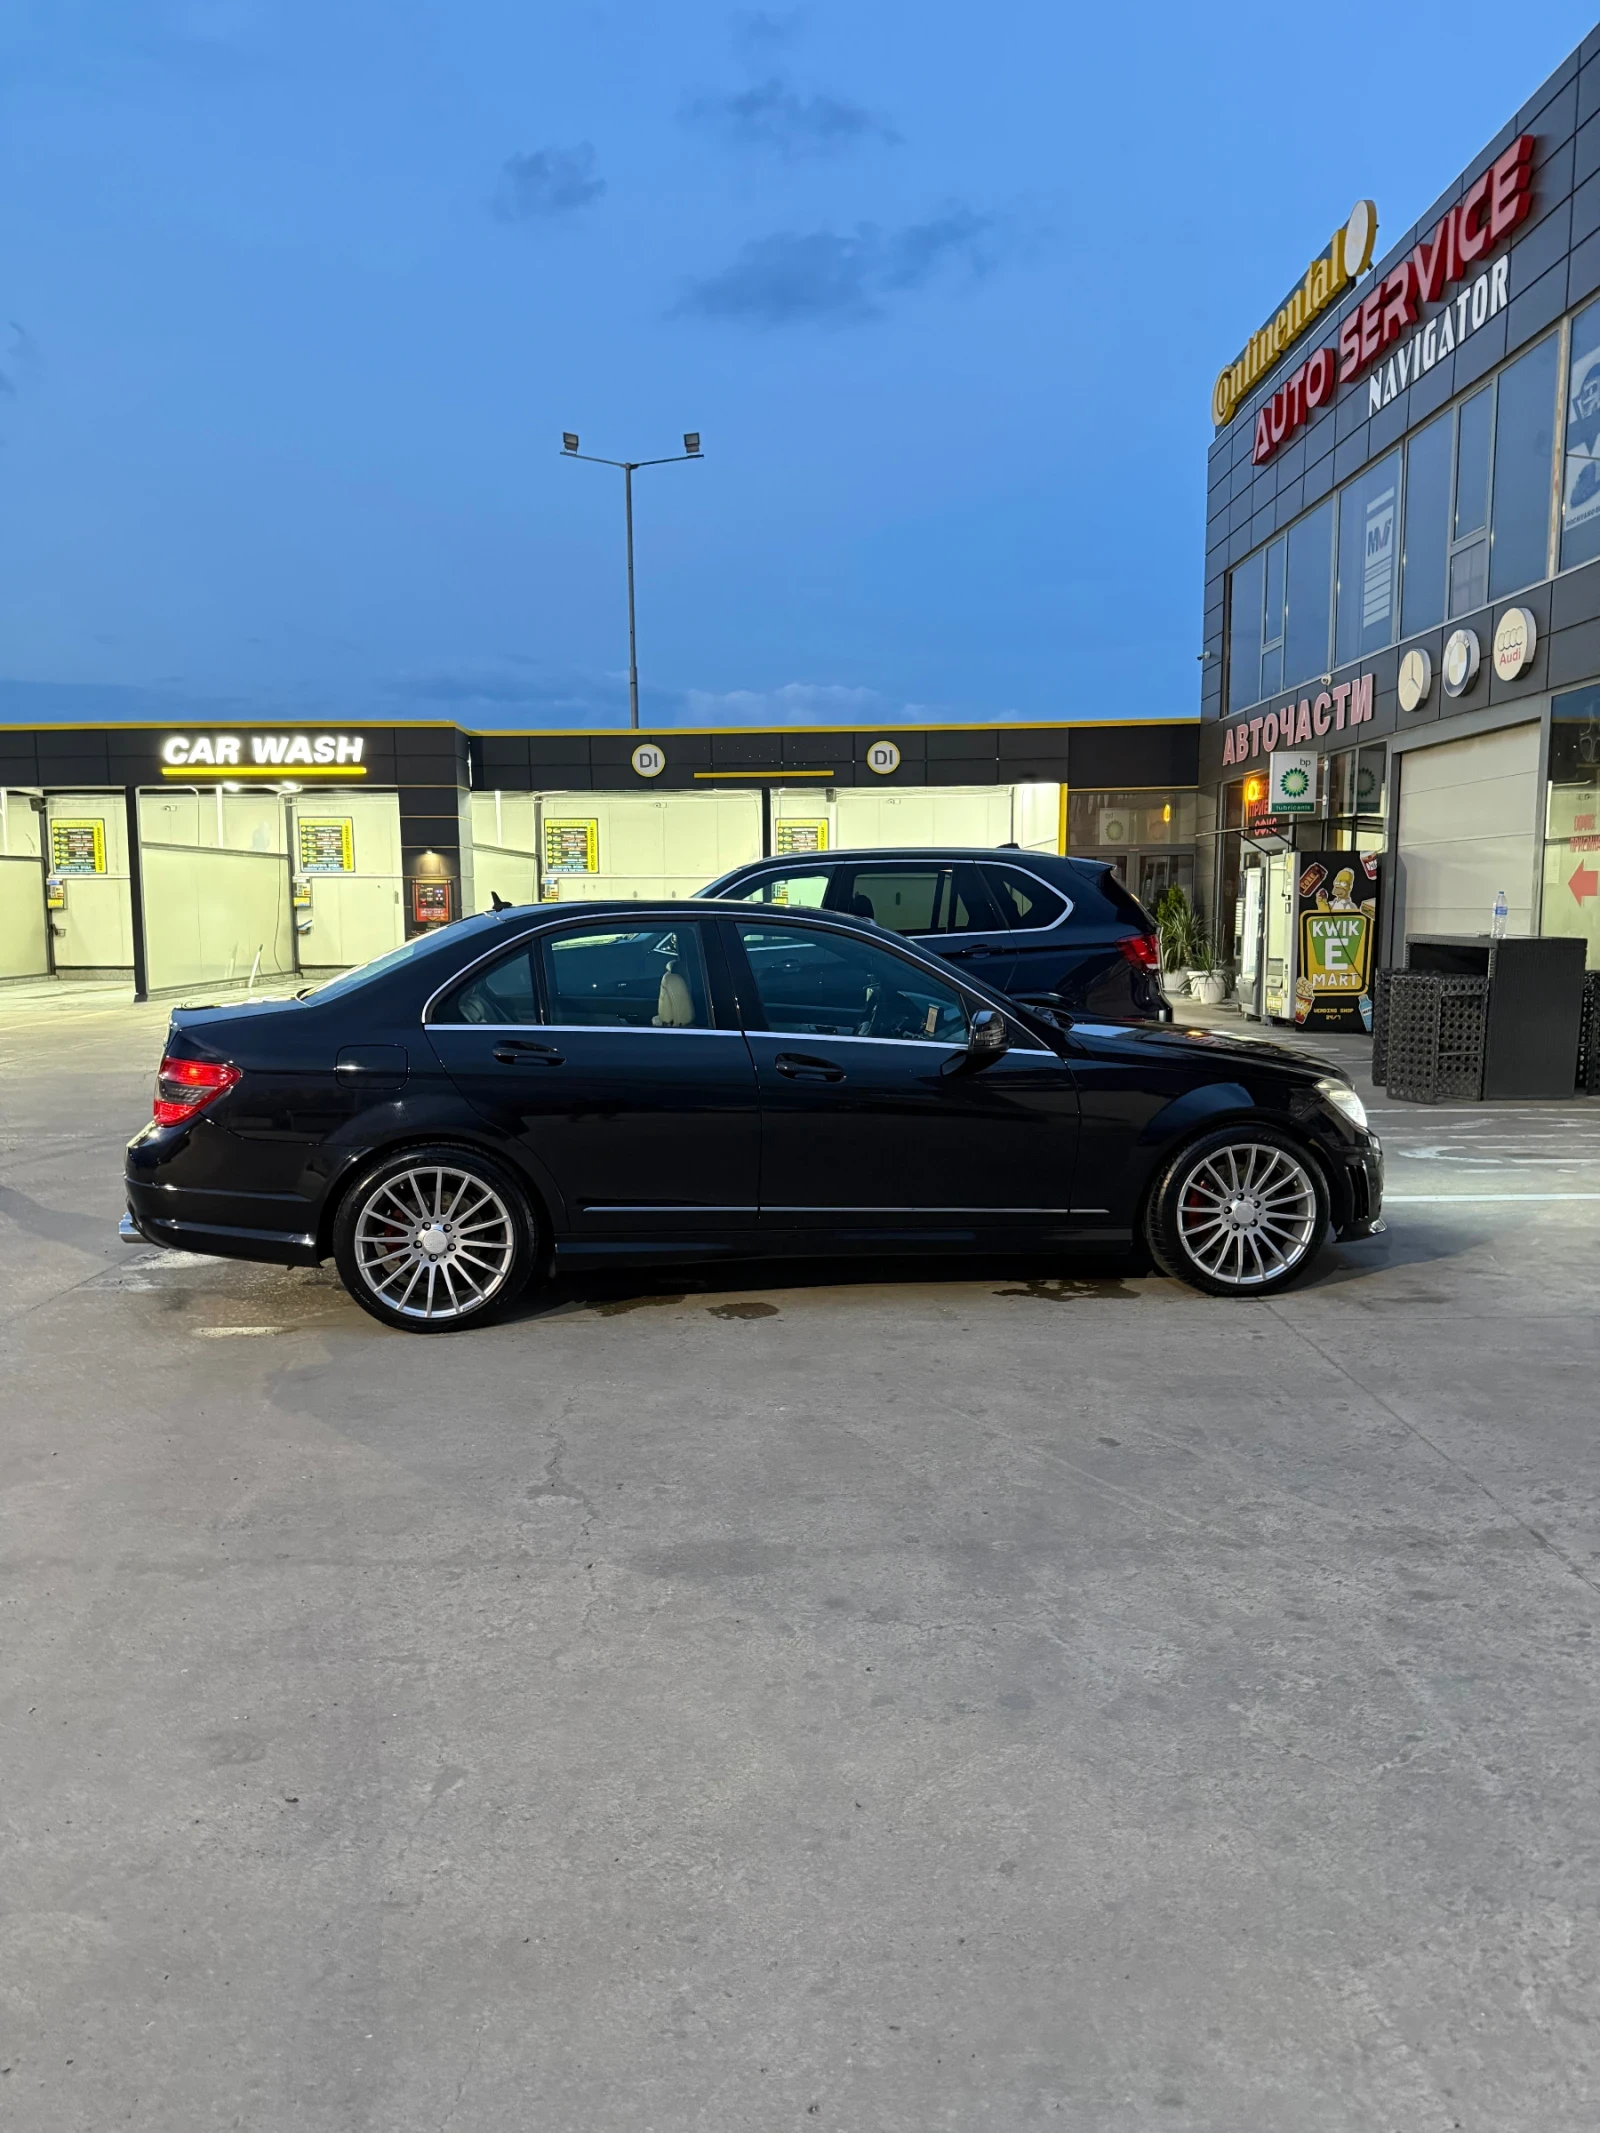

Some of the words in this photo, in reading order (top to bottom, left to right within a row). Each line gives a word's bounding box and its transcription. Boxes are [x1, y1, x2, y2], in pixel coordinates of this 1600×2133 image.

[1252, 347, 1335, 465] AUTO
[1339, 134, 1534, 383] SERVICE
[1212, 228, 1350, 426] Continental
[1368, 254, 1510, 417] NAVIGATOR
[1500, 647, 1521, 666] Audi
[1222, 673, 1374, 766] АВТОЧАСТИ
[164, 736, 240, 764] CAR
[252, 736, 364, 764] WASH
[874, 750, 893, 765] DI
[639, 753, 658, 768] DI
[1299, 758, 1311, 767] bp
[1249, 799, 1269, 818] ПРИЕ
[1312, 920, 1359, 937] KWIK
[1325, 937, 1349, 970] E
[1312, 973, 1359, 987] MART
